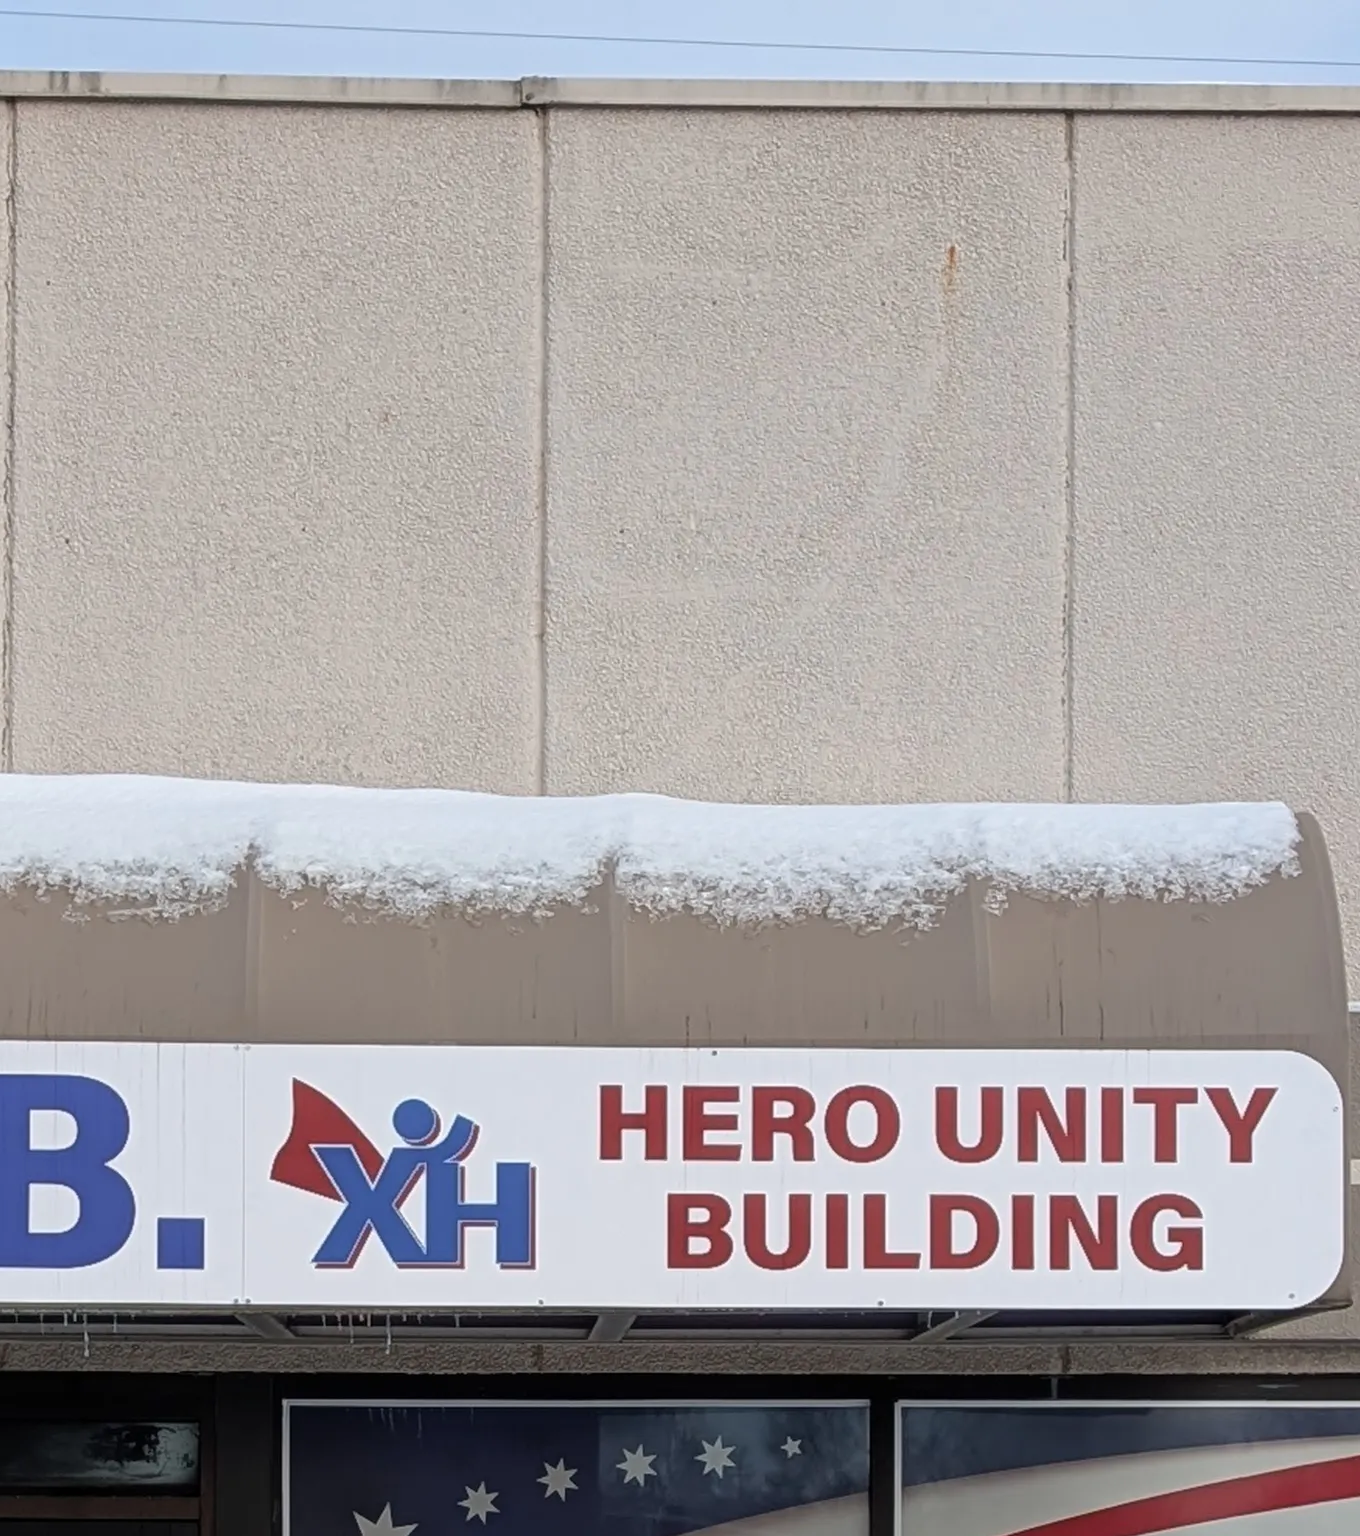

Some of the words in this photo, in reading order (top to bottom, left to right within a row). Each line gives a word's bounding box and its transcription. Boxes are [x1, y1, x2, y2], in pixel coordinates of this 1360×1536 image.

[597, 1084, 901, 1164] HERO
[934, 1085, 1279, 1165] UNITY
[665, 1193, 1205, 1272] BUILDING
